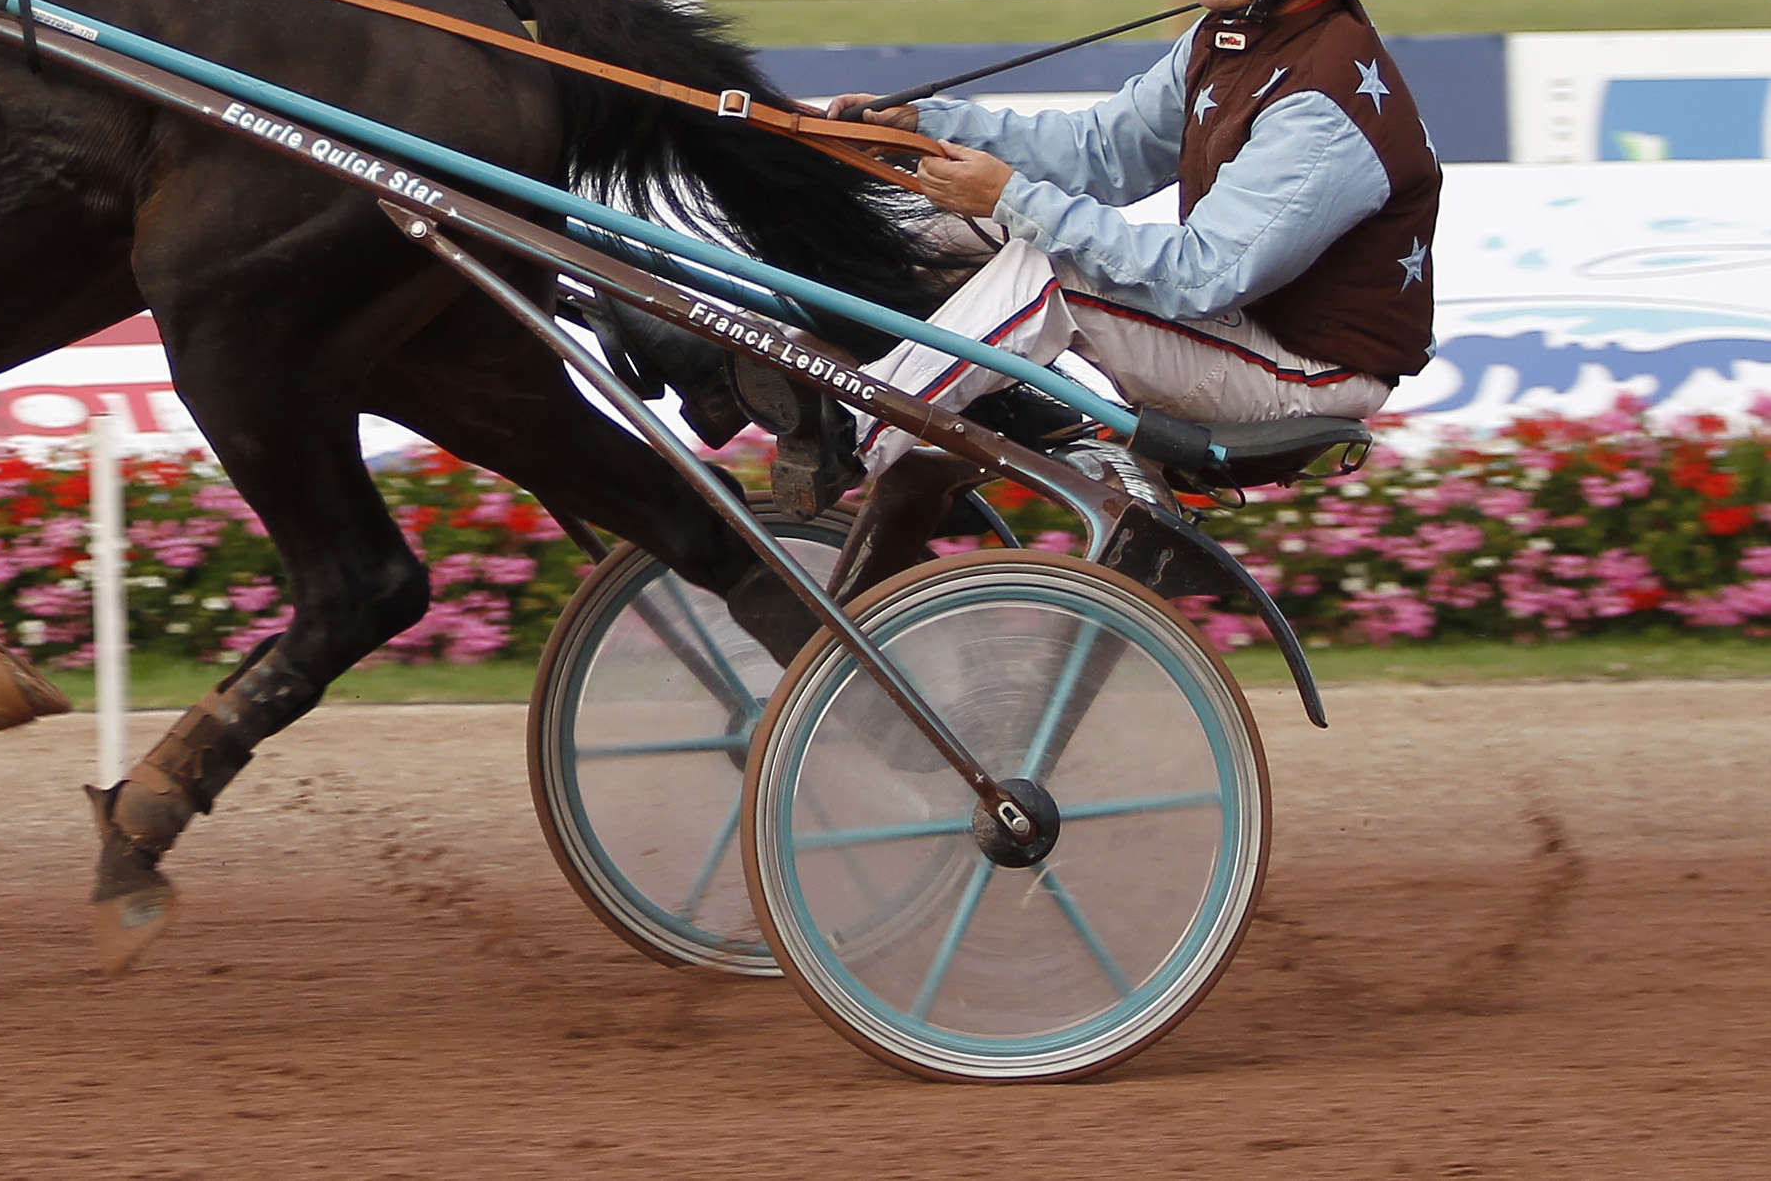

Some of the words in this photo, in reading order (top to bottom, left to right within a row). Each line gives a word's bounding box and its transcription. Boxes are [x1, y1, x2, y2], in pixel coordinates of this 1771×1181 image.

[221, 102, 304, 150] Ecurie
[309, 138, 385, 182] Quick
[388, 170, 444, 206] Star
[688, 301, 775, 353] Franck
[779, 342, 877, 401] Leblanc
